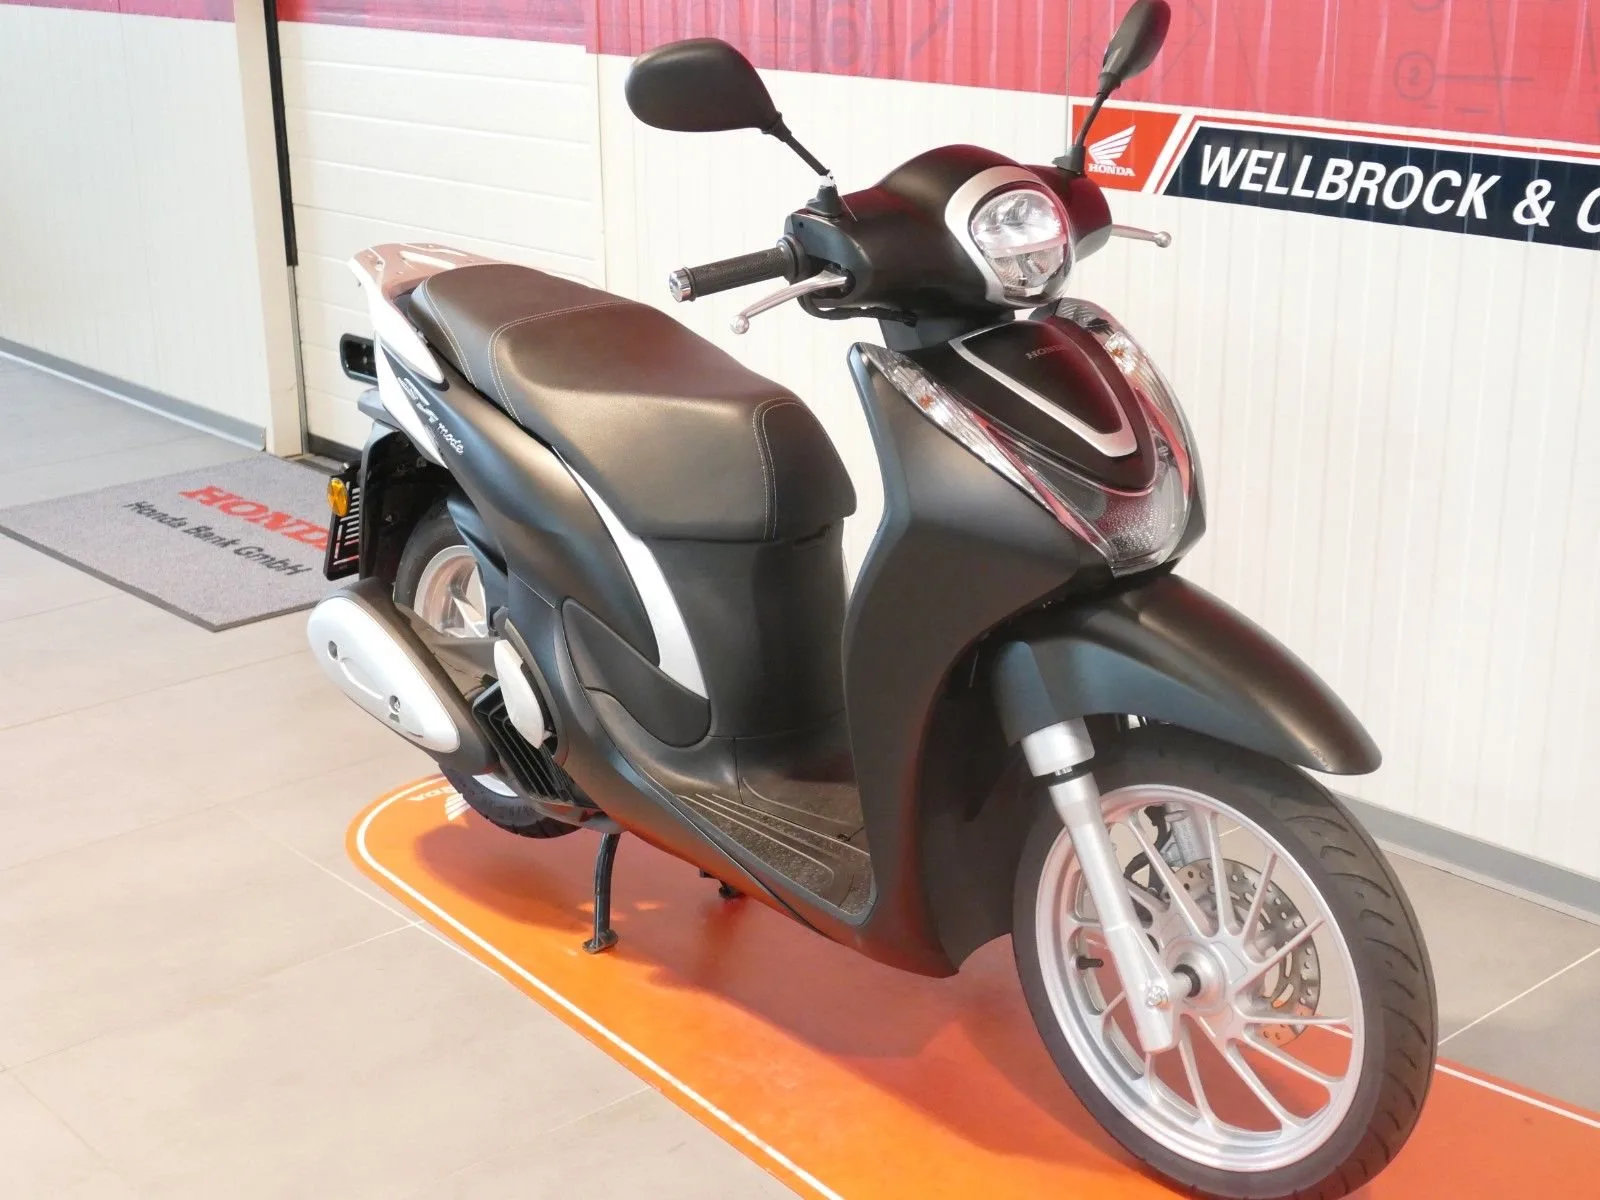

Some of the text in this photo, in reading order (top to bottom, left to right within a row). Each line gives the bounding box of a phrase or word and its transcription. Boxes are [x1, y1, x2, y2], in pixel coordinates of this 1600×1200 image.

[1088, 163, 1136, 177] HONDA
[1200, 144, 1501, 220] WELLBROCK
[1512, 179, 1556, 227] &
[438, 422, 464, 455] mode
[123, 500, 312, 576] Honda Bank GmbH
[180, 485, 329, 552] HOND
